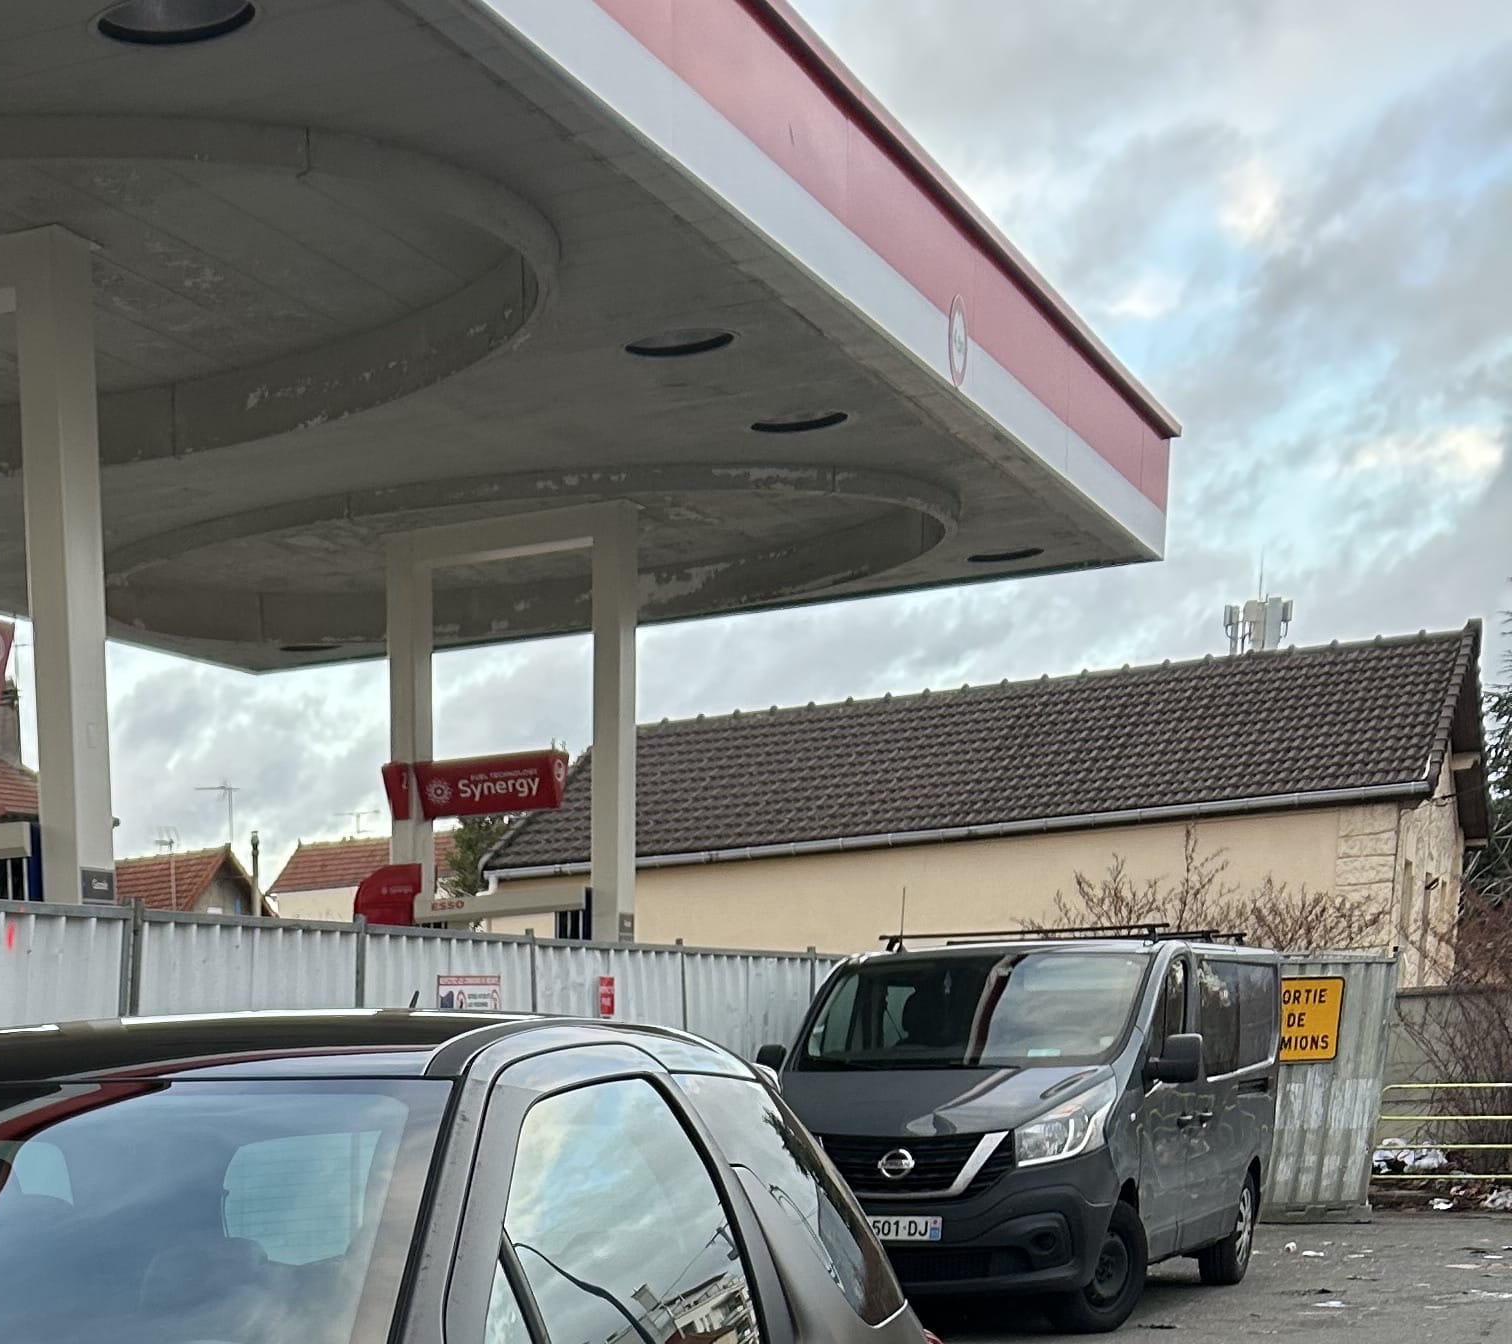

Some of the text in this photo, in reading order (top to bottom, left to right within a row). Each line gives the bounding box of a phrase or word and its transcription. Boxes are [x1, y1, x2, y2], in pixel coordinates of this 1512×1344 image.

[457, 777, 540, 802] Synergy
[431, 900, 464, 911] ESSO
[1282, 988, 1328, 1005] ORTIE
[1287, 1012, 1306, 1028] DE
[1280, 1034, 1330, 1051] MIONS
[872, 1220, 928, 1237] 501-DJ
